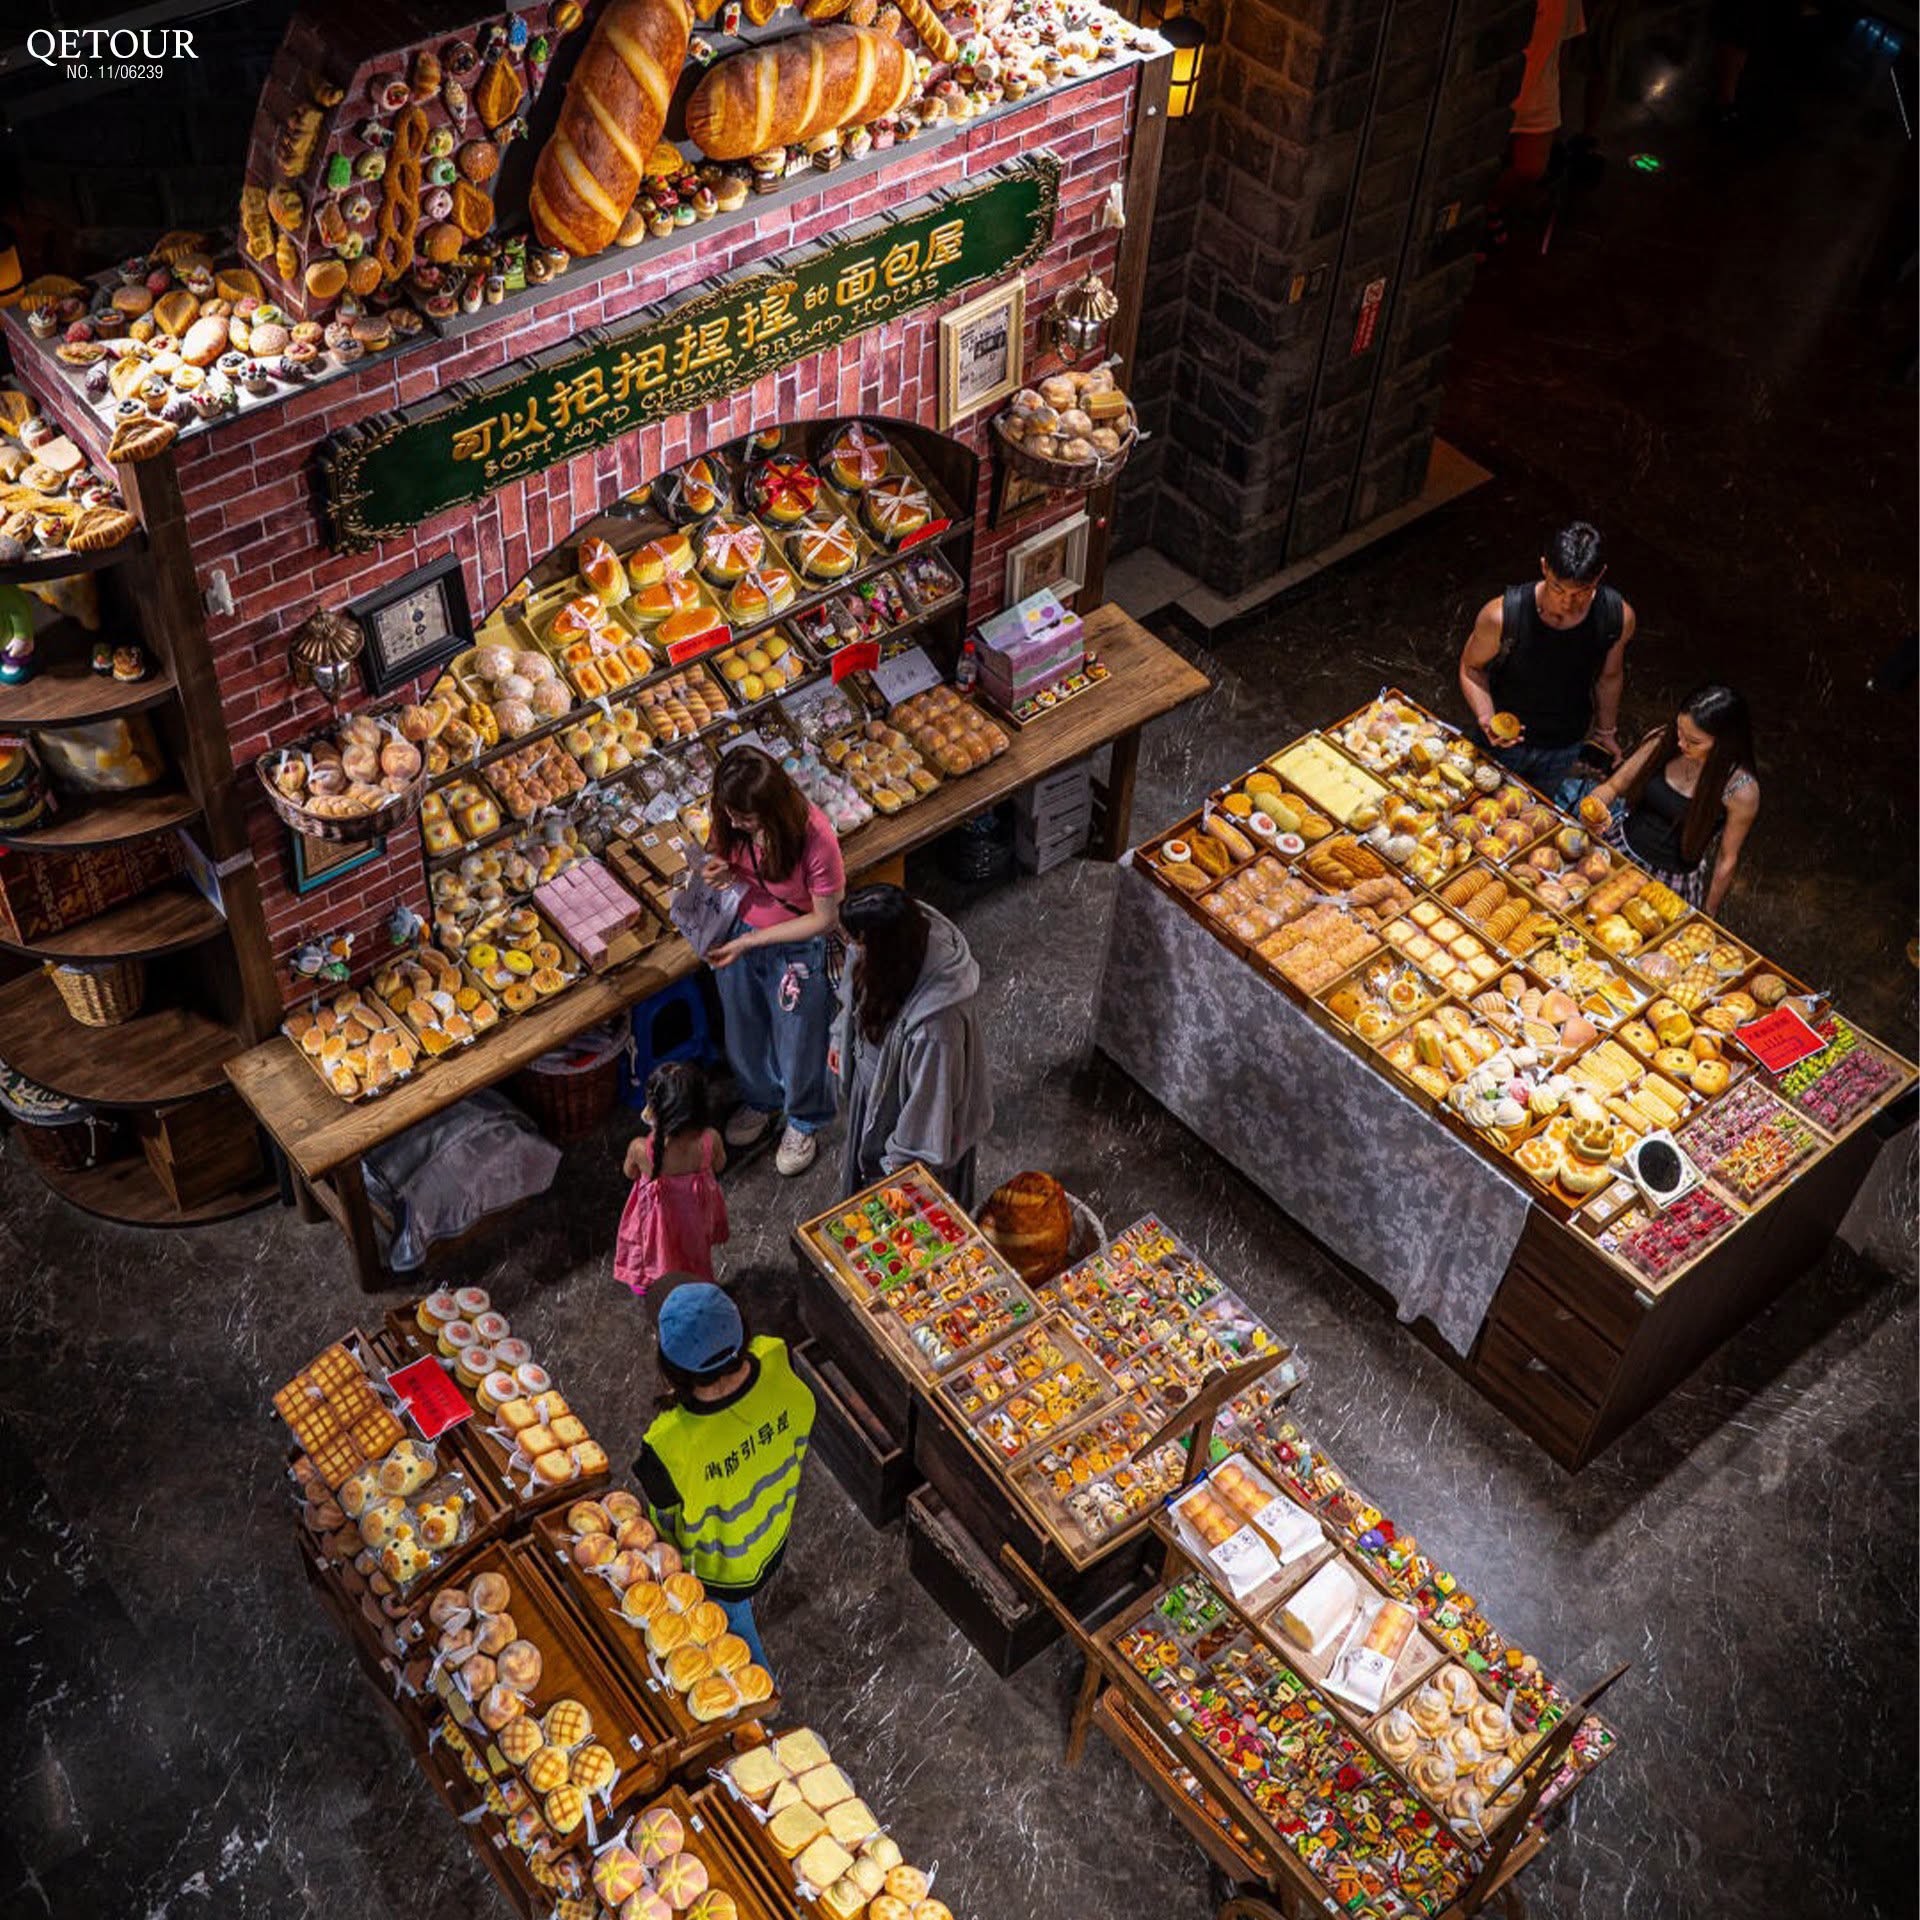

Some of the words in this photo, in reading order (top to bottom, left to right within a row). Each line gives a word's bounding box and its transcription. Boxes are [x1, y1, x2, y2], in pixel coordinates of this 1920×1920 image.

[484, 432, 555, 478] SOFT
[564, 405, 631, 444] AND
[640, 353, 745, 411] CHEWY
[753, 314, 843, 362] BREAD
[851, 272, 939, 324] HOUSE
